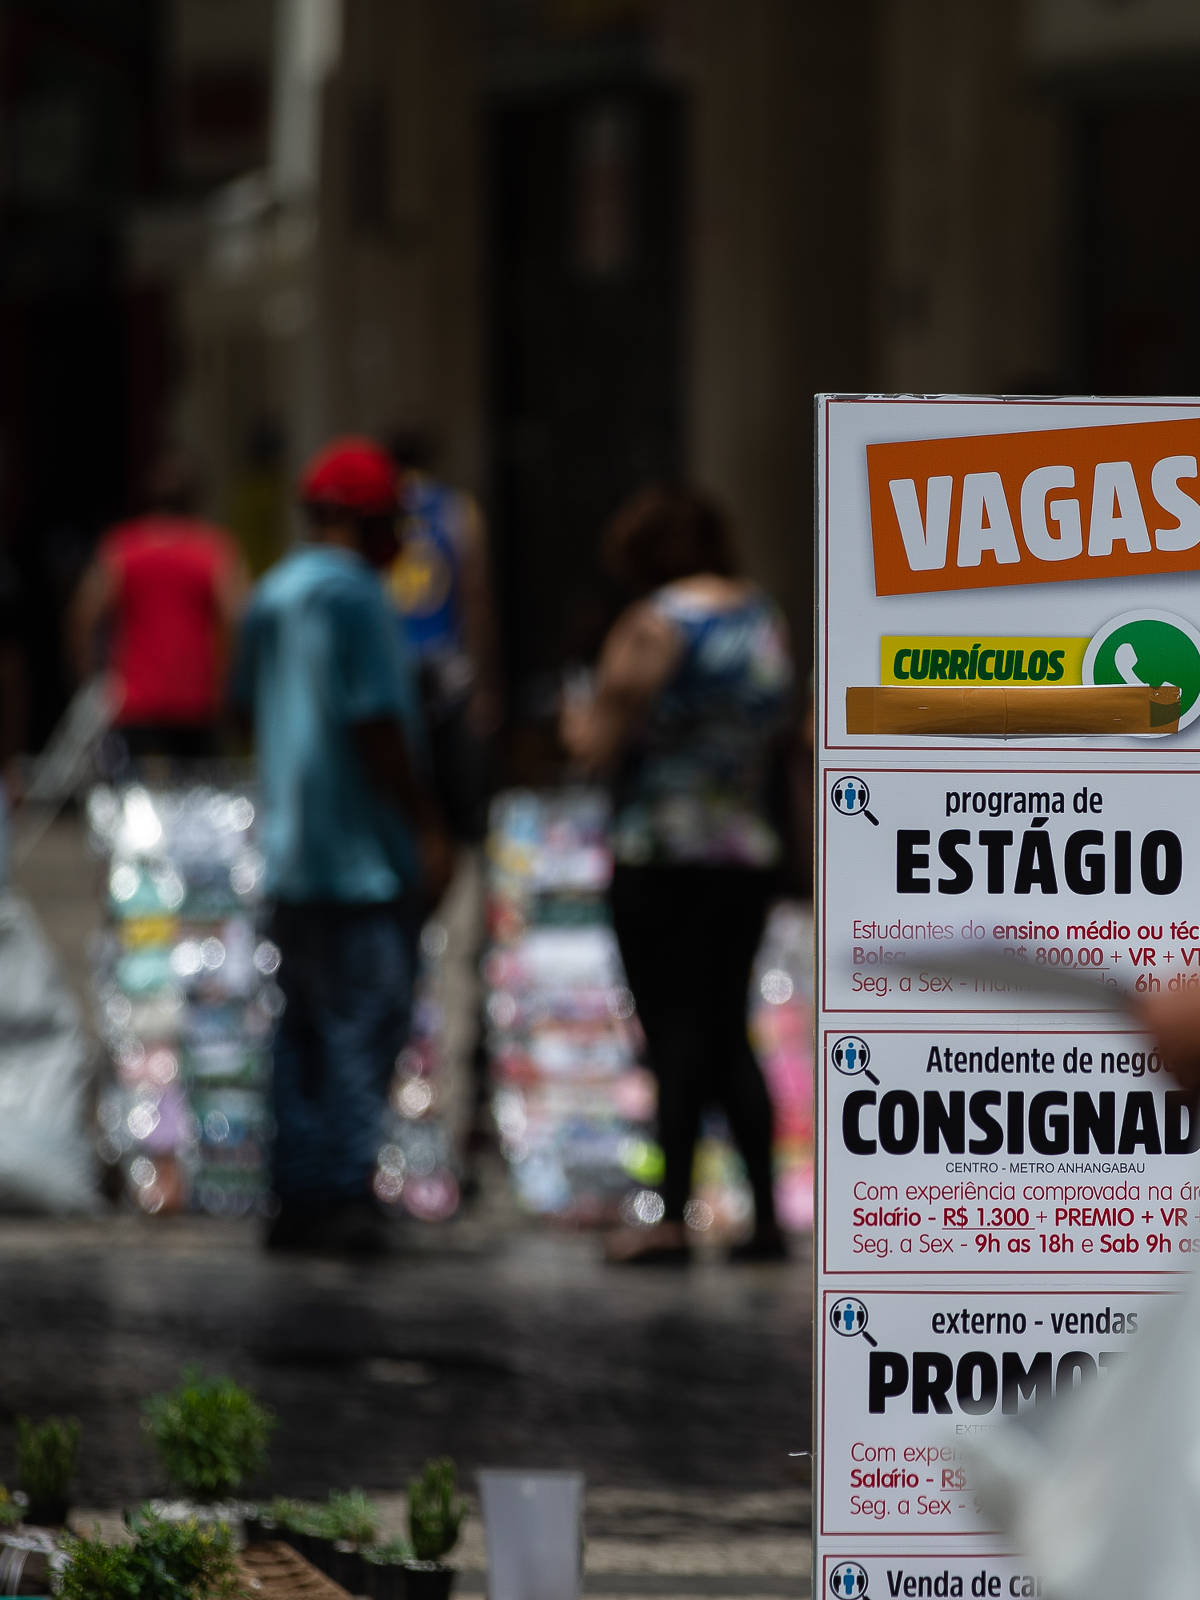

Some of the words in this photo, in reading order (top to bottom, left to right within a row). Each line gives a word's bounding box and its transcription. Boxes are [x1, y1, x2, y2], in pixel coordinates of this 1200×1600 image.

[893, 643, 1065, 681] CURRÍCULOS
[945, 790, 1065, 817] programa
[1073, 787, 1103, 814] de
[896, 817, 1183, 895] ESTÁGIO
[853, 919, 954, 940] Estudantes
[961, 919, 986, 940] do
[993, 920, 1060, 940] ensino
[1067, 919, 1131, 941] médio
[1137, 924, 1163, 941] ou
[1035, 947, 1104, 968] 800,00
[1110, 951, 1123, 964] +
[1129, 947, 1157, 967] VR
[1163, 951, 1175, 964] +
[852, 972, 892, 997] Seg.
[899, 976, 912, 992] a
[918, 972, 953, 992] Sex
[1136, 973, 1161, 993] 6h
[926, 1046, 1055, 1074] Atendente
[1063, 1046, 1092, 1074] de
[945, 1162, 999, 1174] CENTRO
[1009, 1162, 1055, 1174] METRO
[1057, 1162, 1146, 1174] ANHANGABAU
[853, 1181, 898, 1201] Com
[905, 1180, 1016, 1206] experiência
[1022, 1180, 1140, 1206] comprovada
[1148, 1185, 1172, 1201] na
[852, 1206, 922, 1228] Salário
[943, 1206, 969, 1229] R$
[977, 1207, 1030, 1228] 1.300
[1036, 1211, 1048, 1224] +
[1055, 1207, 1135, 1227] PREMIO
[1141, 1210, 1154, 1224] +
[1160, 1207, 1188, 1227] VR
[852, 1233, 894, 1258] Seg.
[900, 1237, 913, 1253] a
[919, 1233, 954, 1253] Sex
[975, 1233, 1000, 1253] 9h
[1007, 1238, 1032, 1254] as
[1039, 1233, 1074, 1253] 18h
[1081, 1237, 1094, 1253] e
[1100, 1233, 1139, 1253] Sab
[1146, 1233, 1172, 1253] 9h
[931, 1309, 1027, 1334] externo
[1051, 1307, 1139, 1334] vendas
[851, 1442, 896, 1463] Com
[850, 1467, 919, 1489] Salário
[941, 1467, 967, 1490] R$
[850, 1495, 890, 1520] Seg.
[897, 1500, 910, 1515] a
[917, 1495, 952, 1515] Sex
[887, 1570, 963, 1598] Venda
[971, 1570, 1001, 1598] de
